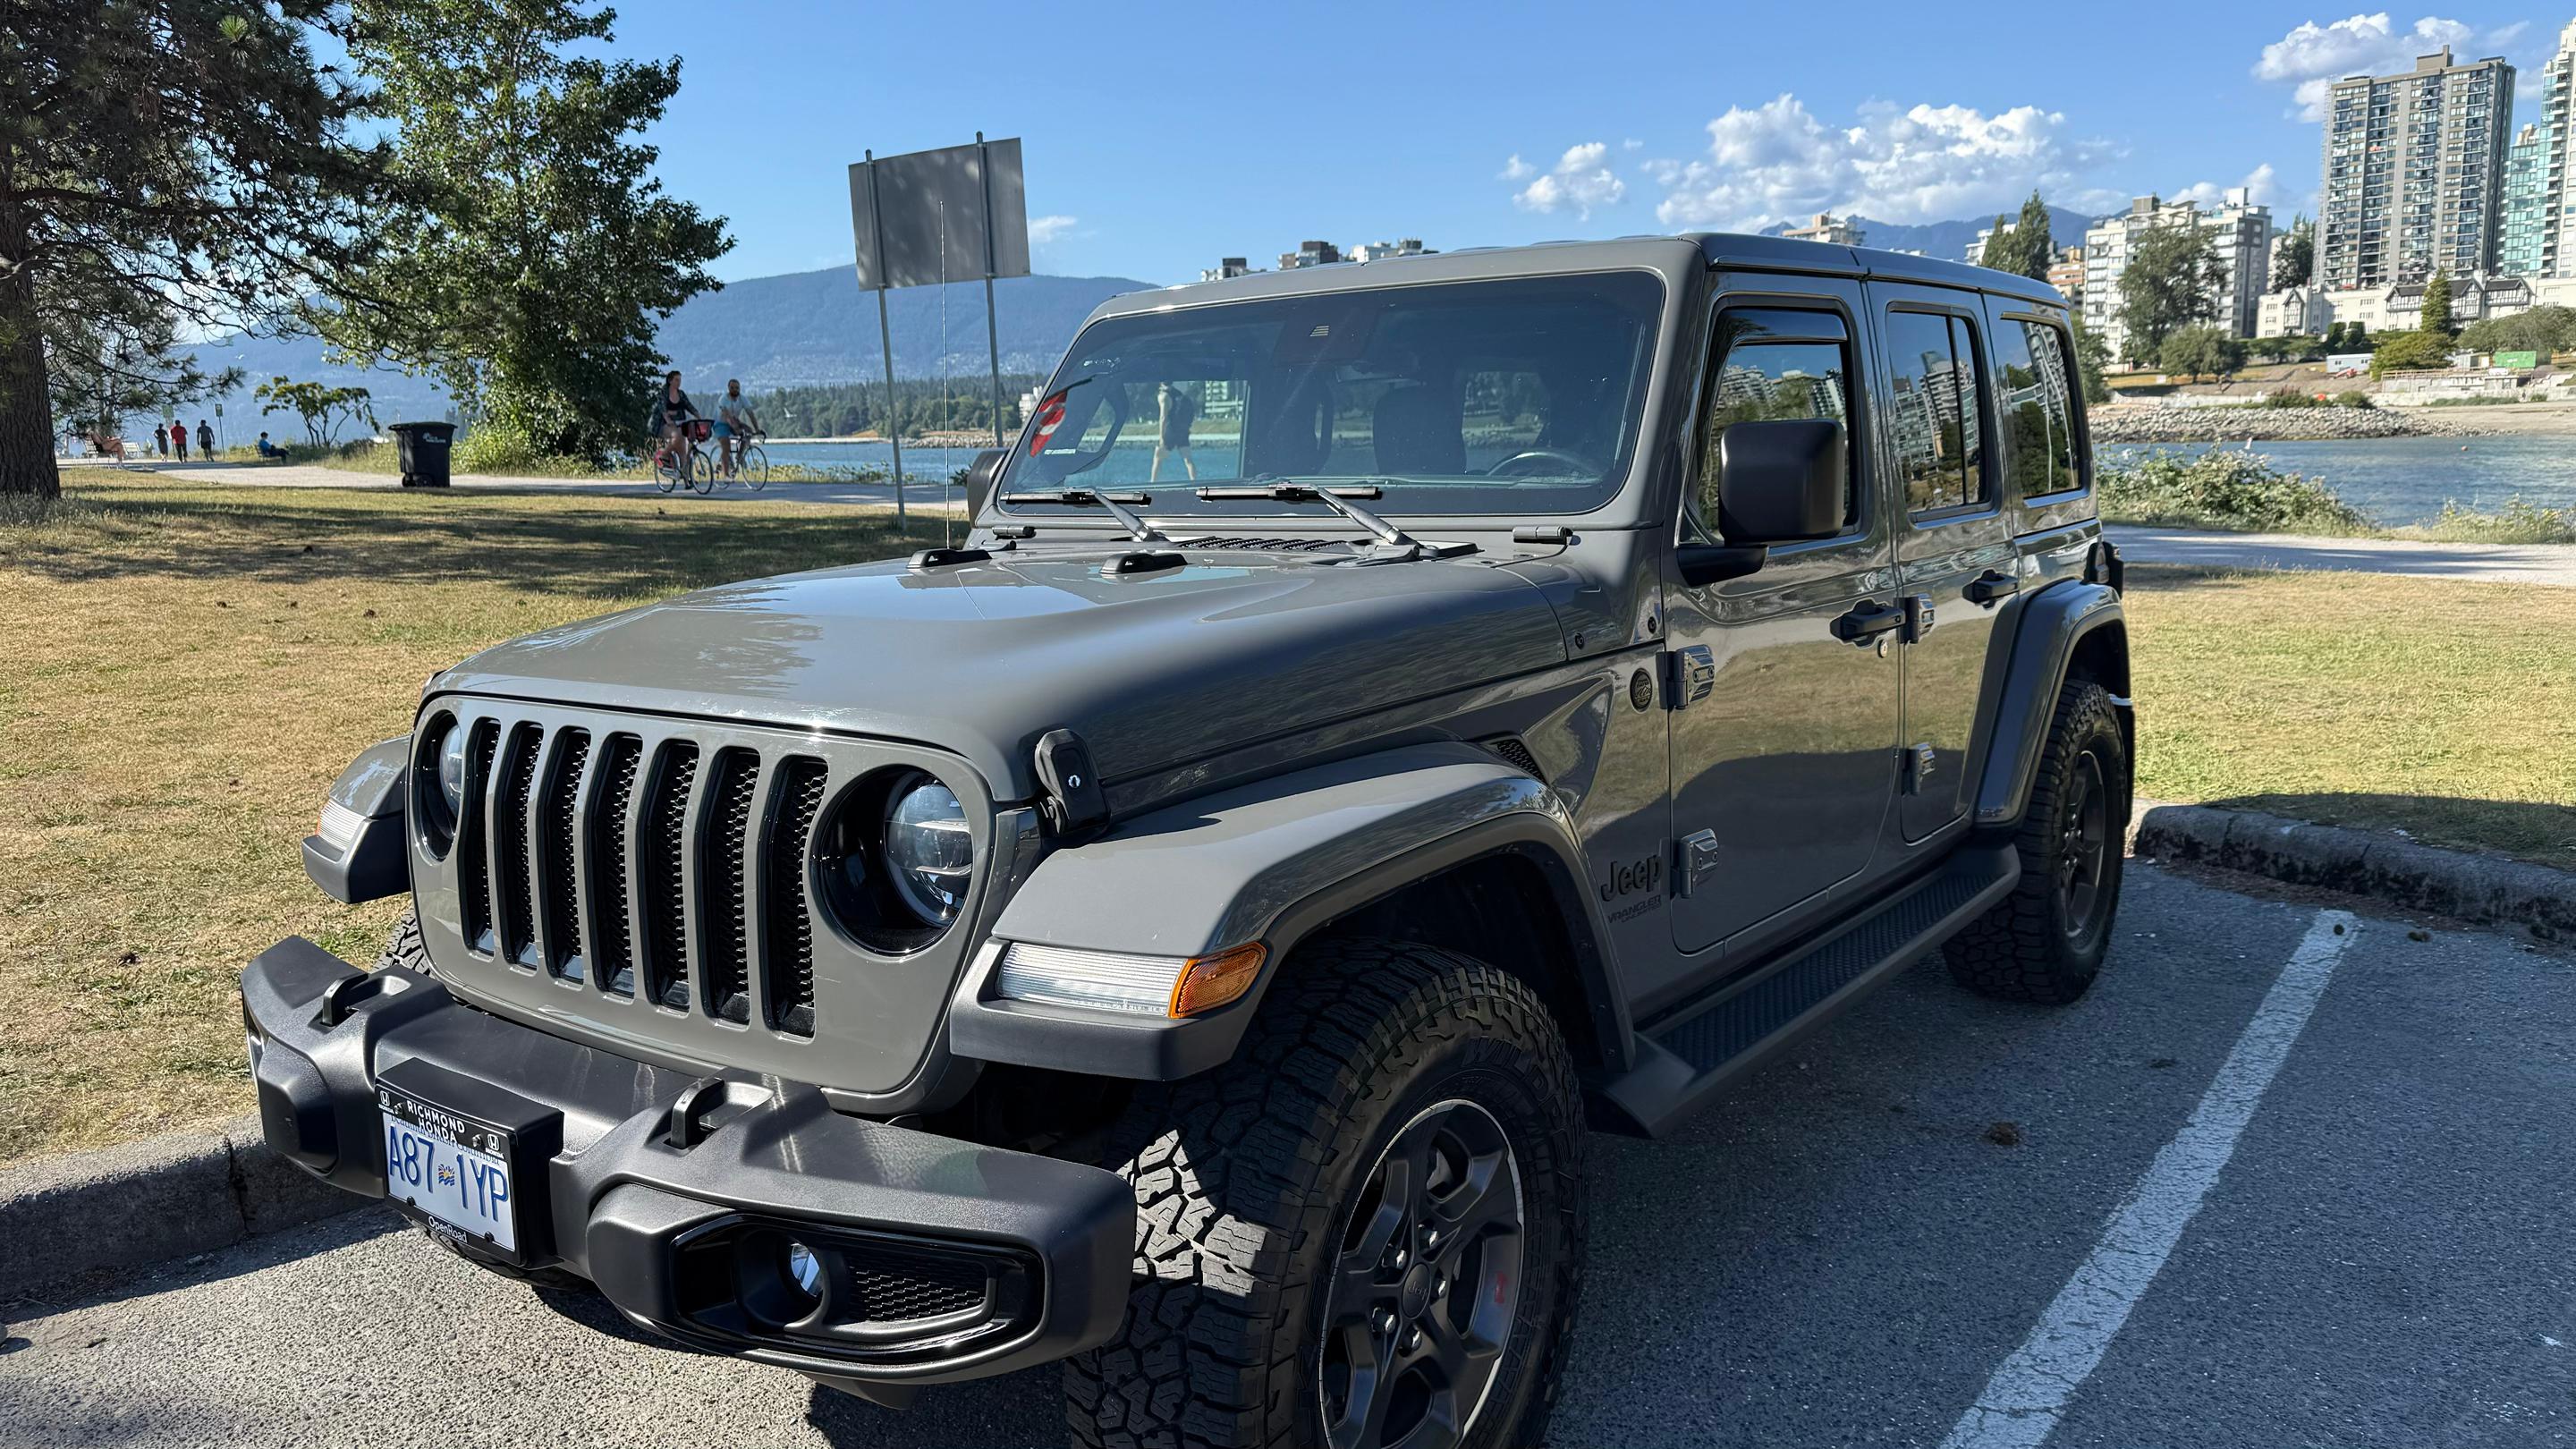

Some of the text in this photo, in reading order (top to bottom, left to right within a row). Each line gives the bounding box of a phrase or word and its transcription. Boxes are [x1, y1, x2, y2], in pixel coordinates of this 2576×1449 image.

[1600, 854, 1662, 902] Jeep
[1607, 895, 1662, 923] WRANGLER
[406, 1099, 465, 1133] RICHMOND
[418, 1117, 458, 1144] HONDA
[389, 1123, 509, 1223] A87 1YP
[428, 1216, 467, 1243] OpenRoad
